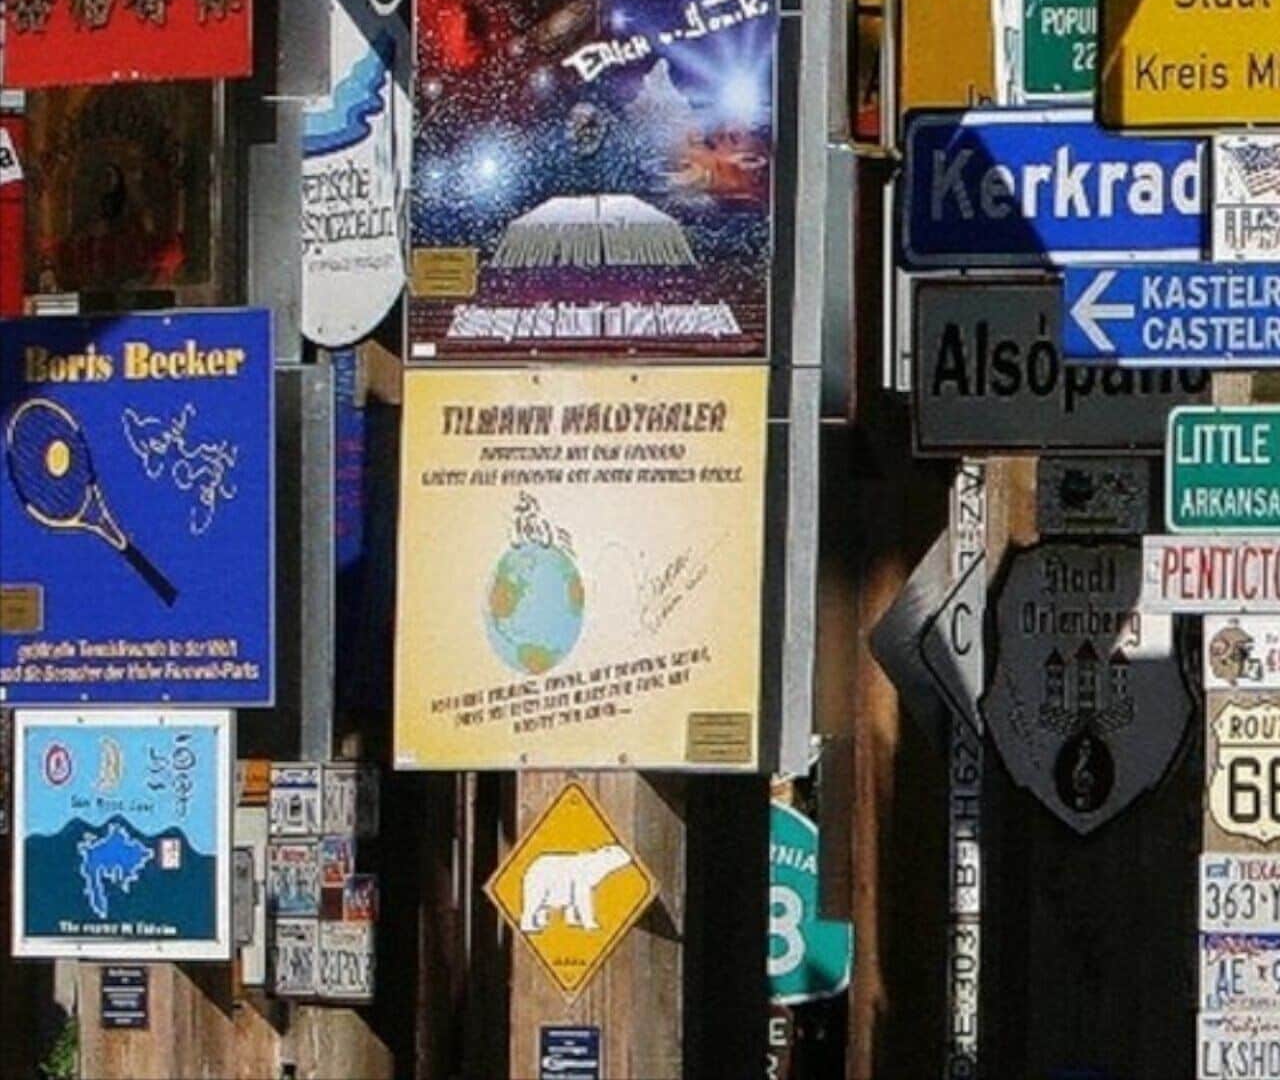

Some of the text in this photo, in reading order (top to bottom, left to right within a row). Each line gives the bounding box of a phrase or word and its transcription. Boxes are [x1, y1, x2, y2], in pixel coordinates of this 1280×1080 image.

[1135, 54, 1229, 91] Kreis
[26, 341, 245, 382] Boris Becker
[443, 405, 553, 436] TILMANN
[1176, 423, 1270, 466] LITTLE
